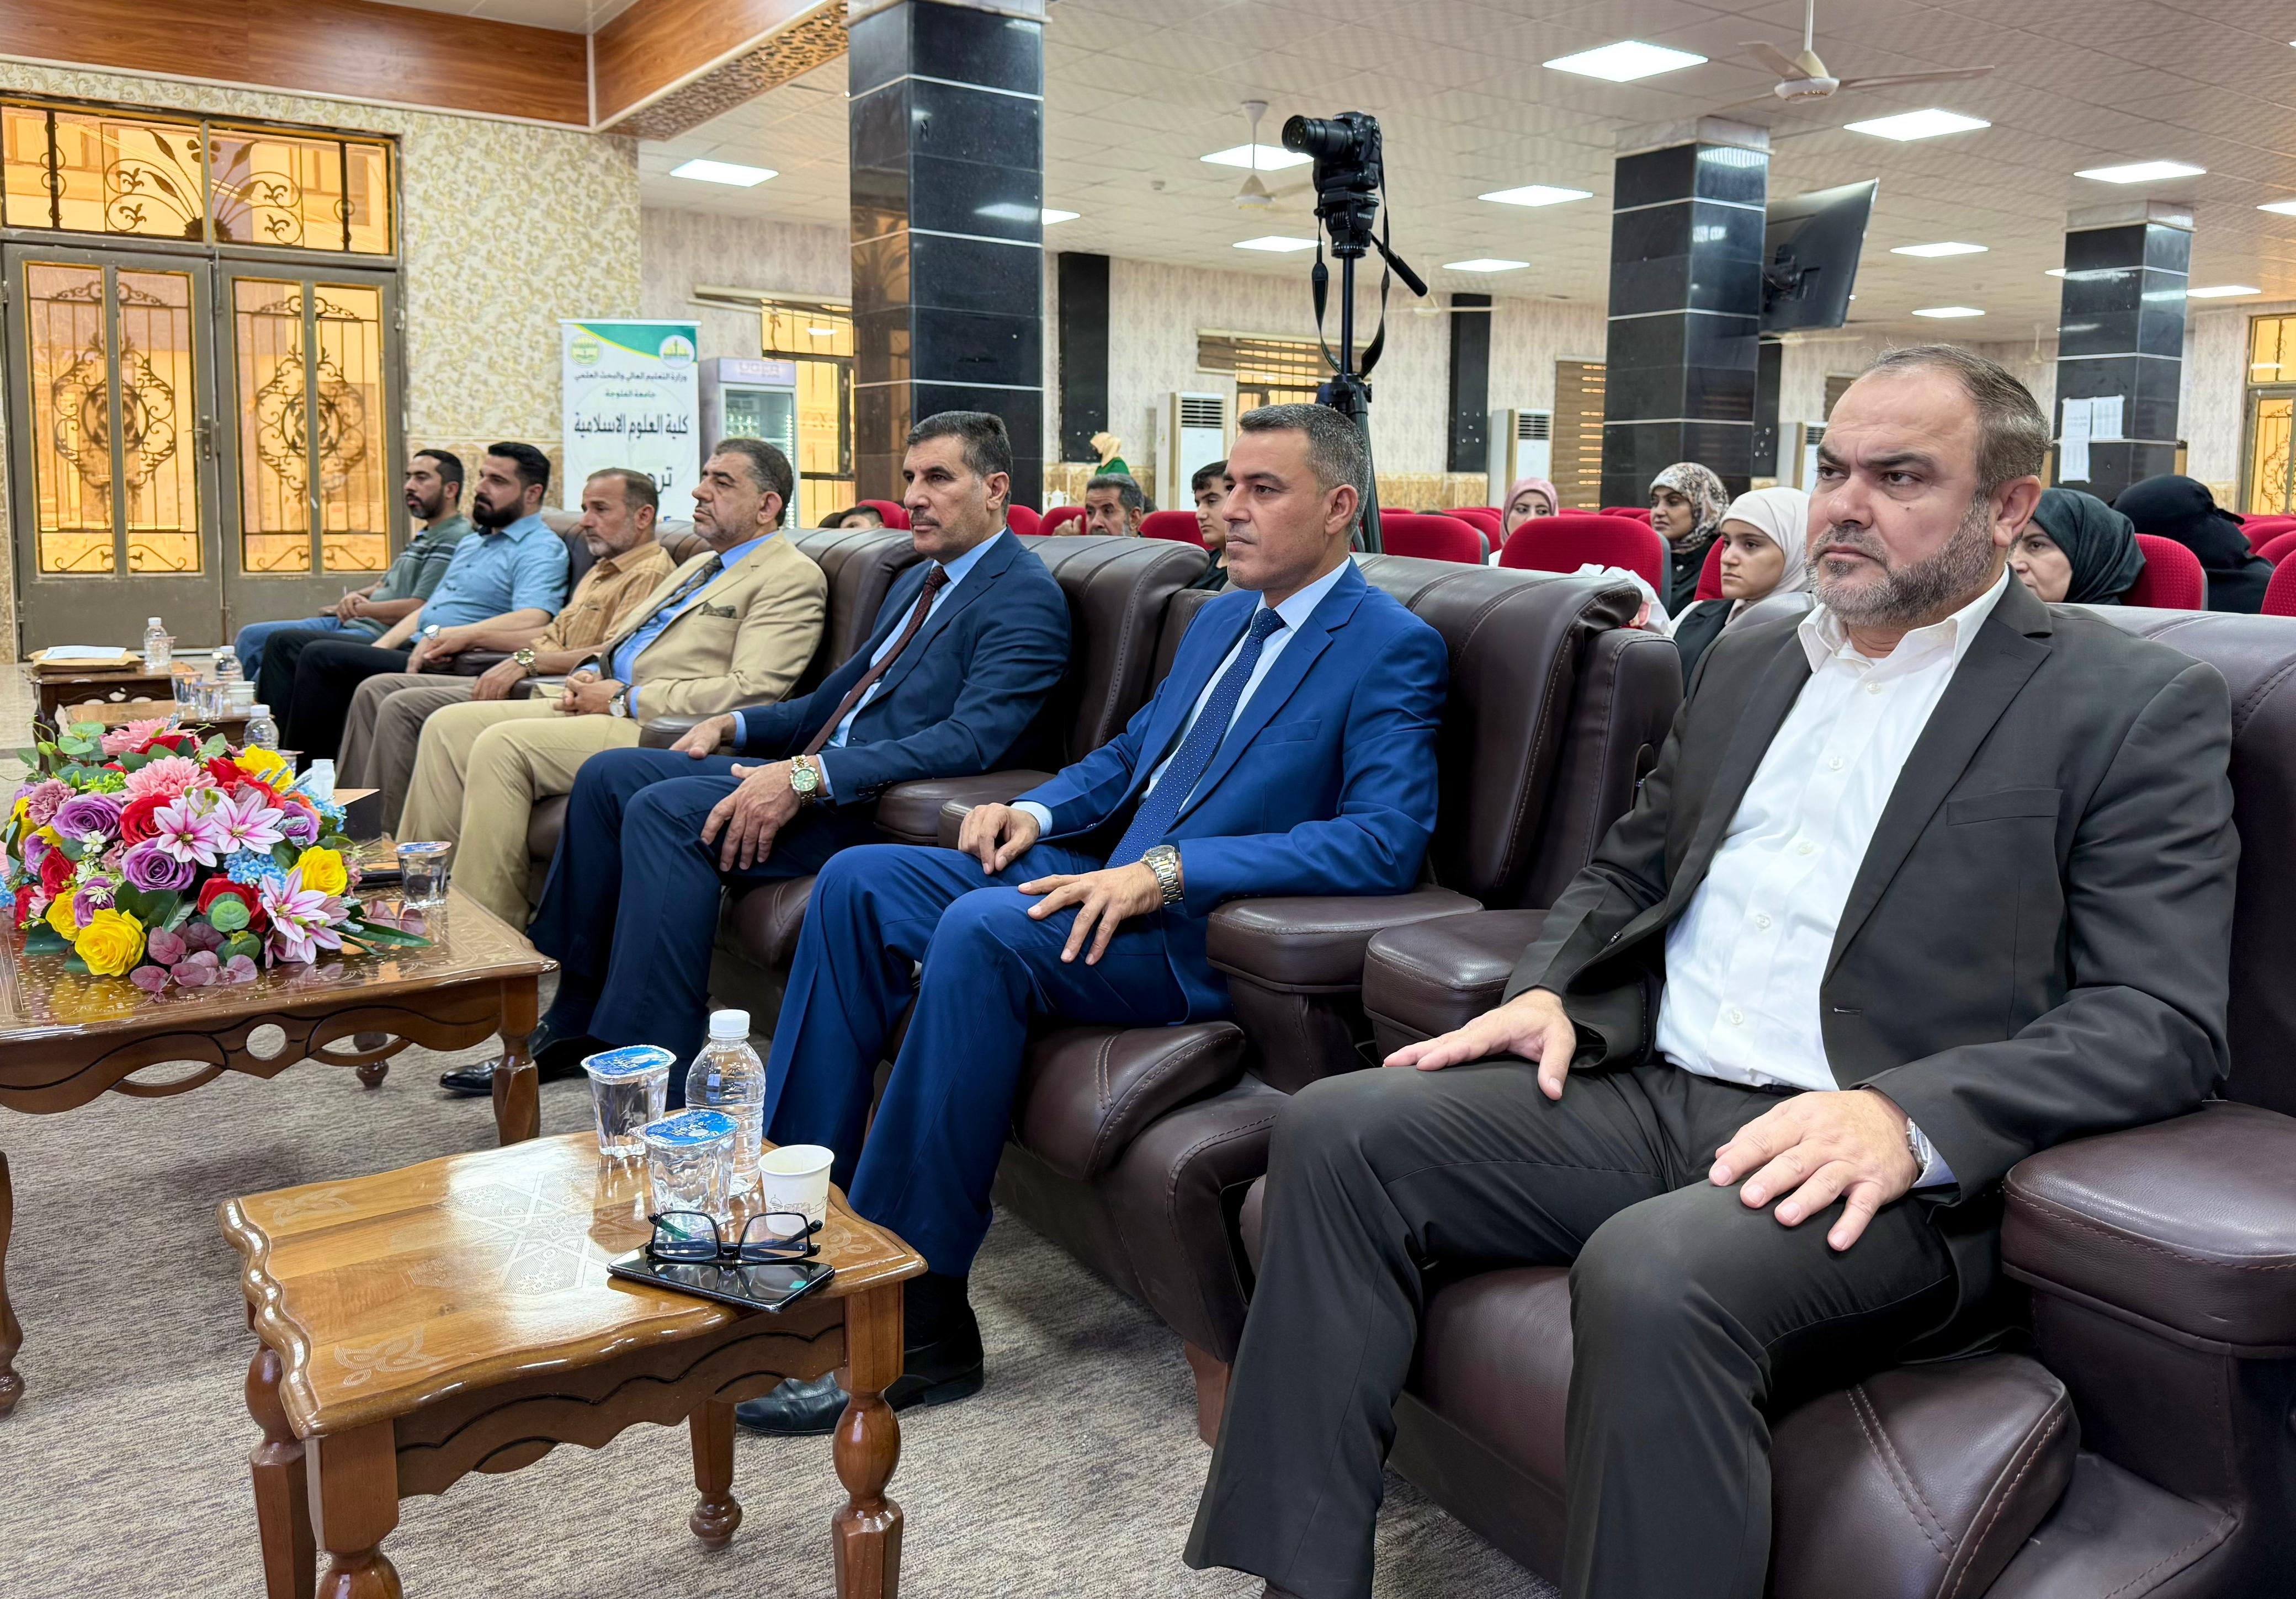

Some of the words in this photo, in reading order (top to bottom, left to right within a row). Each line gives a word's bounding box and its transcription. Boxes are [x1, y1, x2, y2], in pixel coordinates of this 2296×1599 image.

[575, 370, 598, 382] العلمي
[600, 371, 625, 380] والبحث
[626, 371, 645, 382] العالي
[646, 371, 670, 380] التعليم
[671, 372, 687, 382] وزارة
[575, 412, 626, 439] الاسلامية
[628, 413, 662, 442] العلوم
[666, 413, 689, 439] كلية
